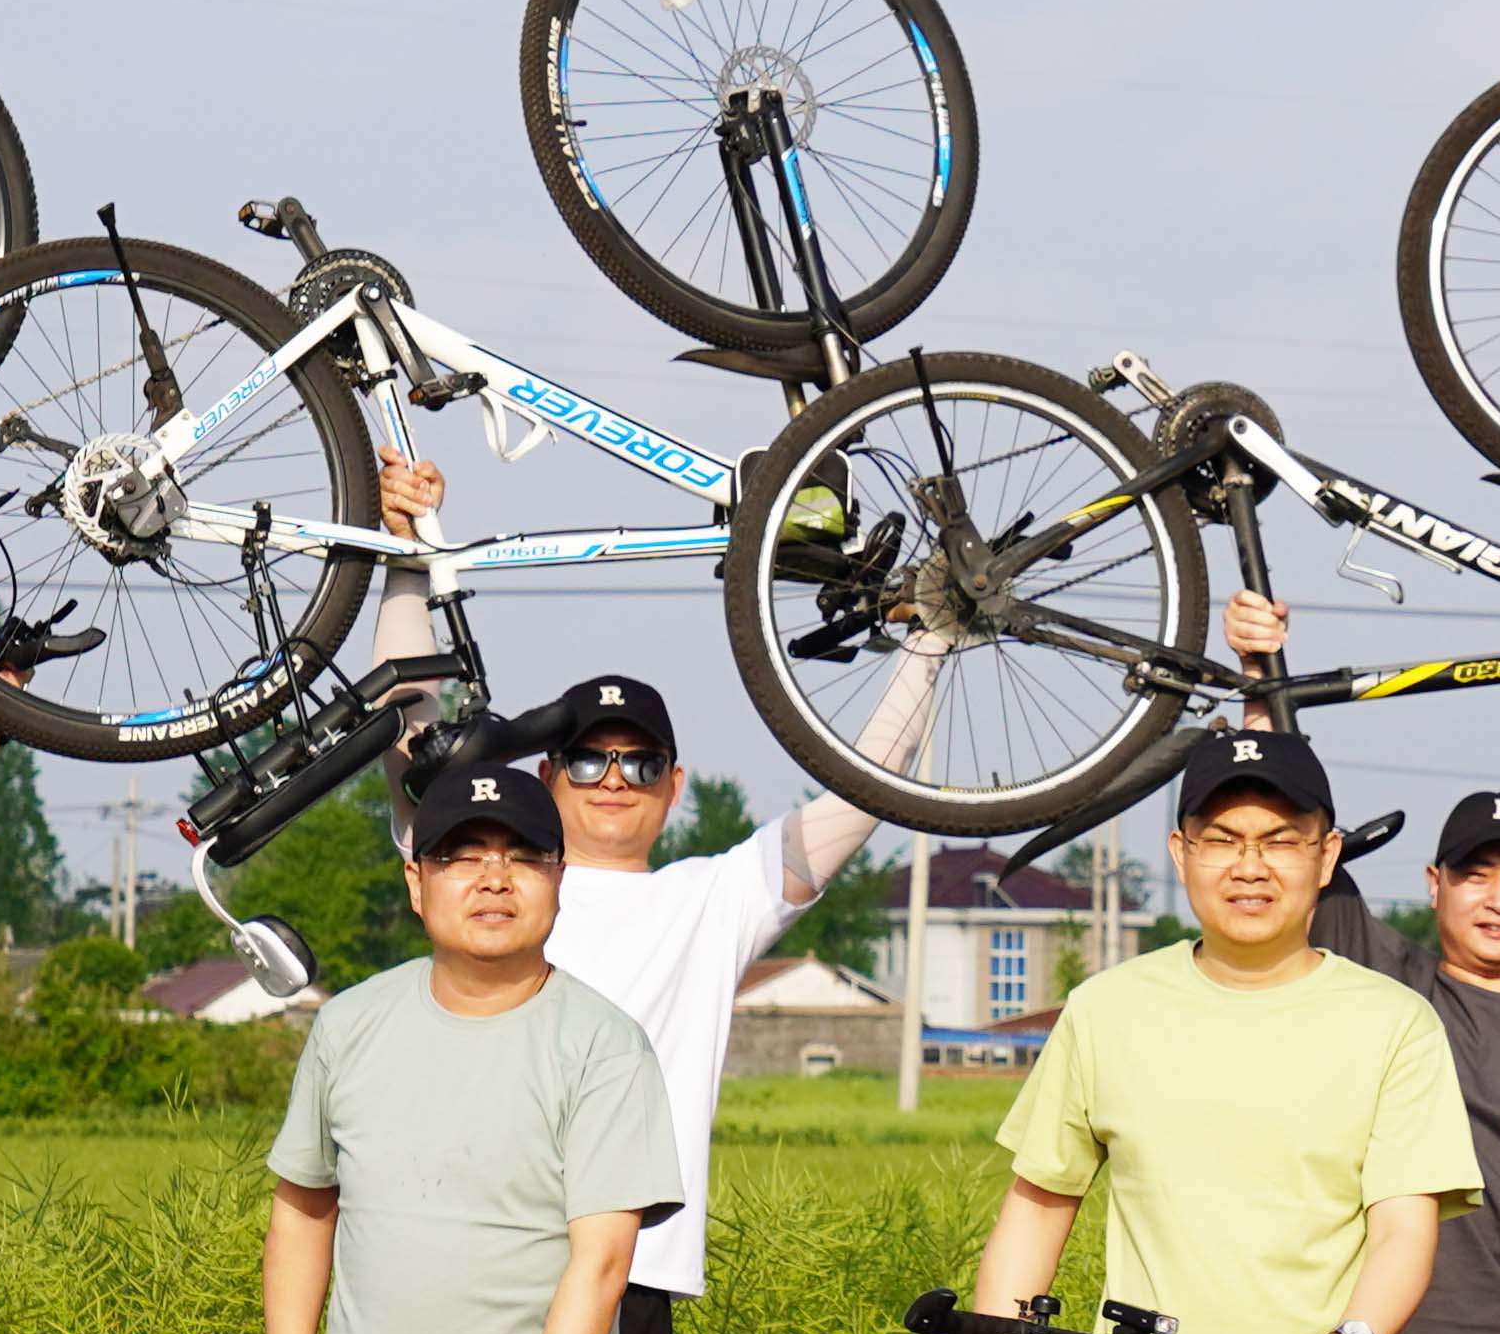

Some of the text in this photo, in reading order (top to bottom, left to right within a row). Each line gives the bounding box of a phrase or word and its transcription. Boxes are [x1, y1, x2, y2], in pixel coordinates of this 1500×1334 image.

[546, 17, 563, 116] TERRAINS
[555, 123, 574, 158] ALL
[193, 360, 277, 440] FOREVER
[507, 379, 725, 488] FOREVER
[219, 690, 259, 721] ALL
[601, 684, 626, 705] R
[118, 711, 219, 742] TERRAINS
[1232, 739, 1263, 764] R
[471, 777, 501, 803] R
